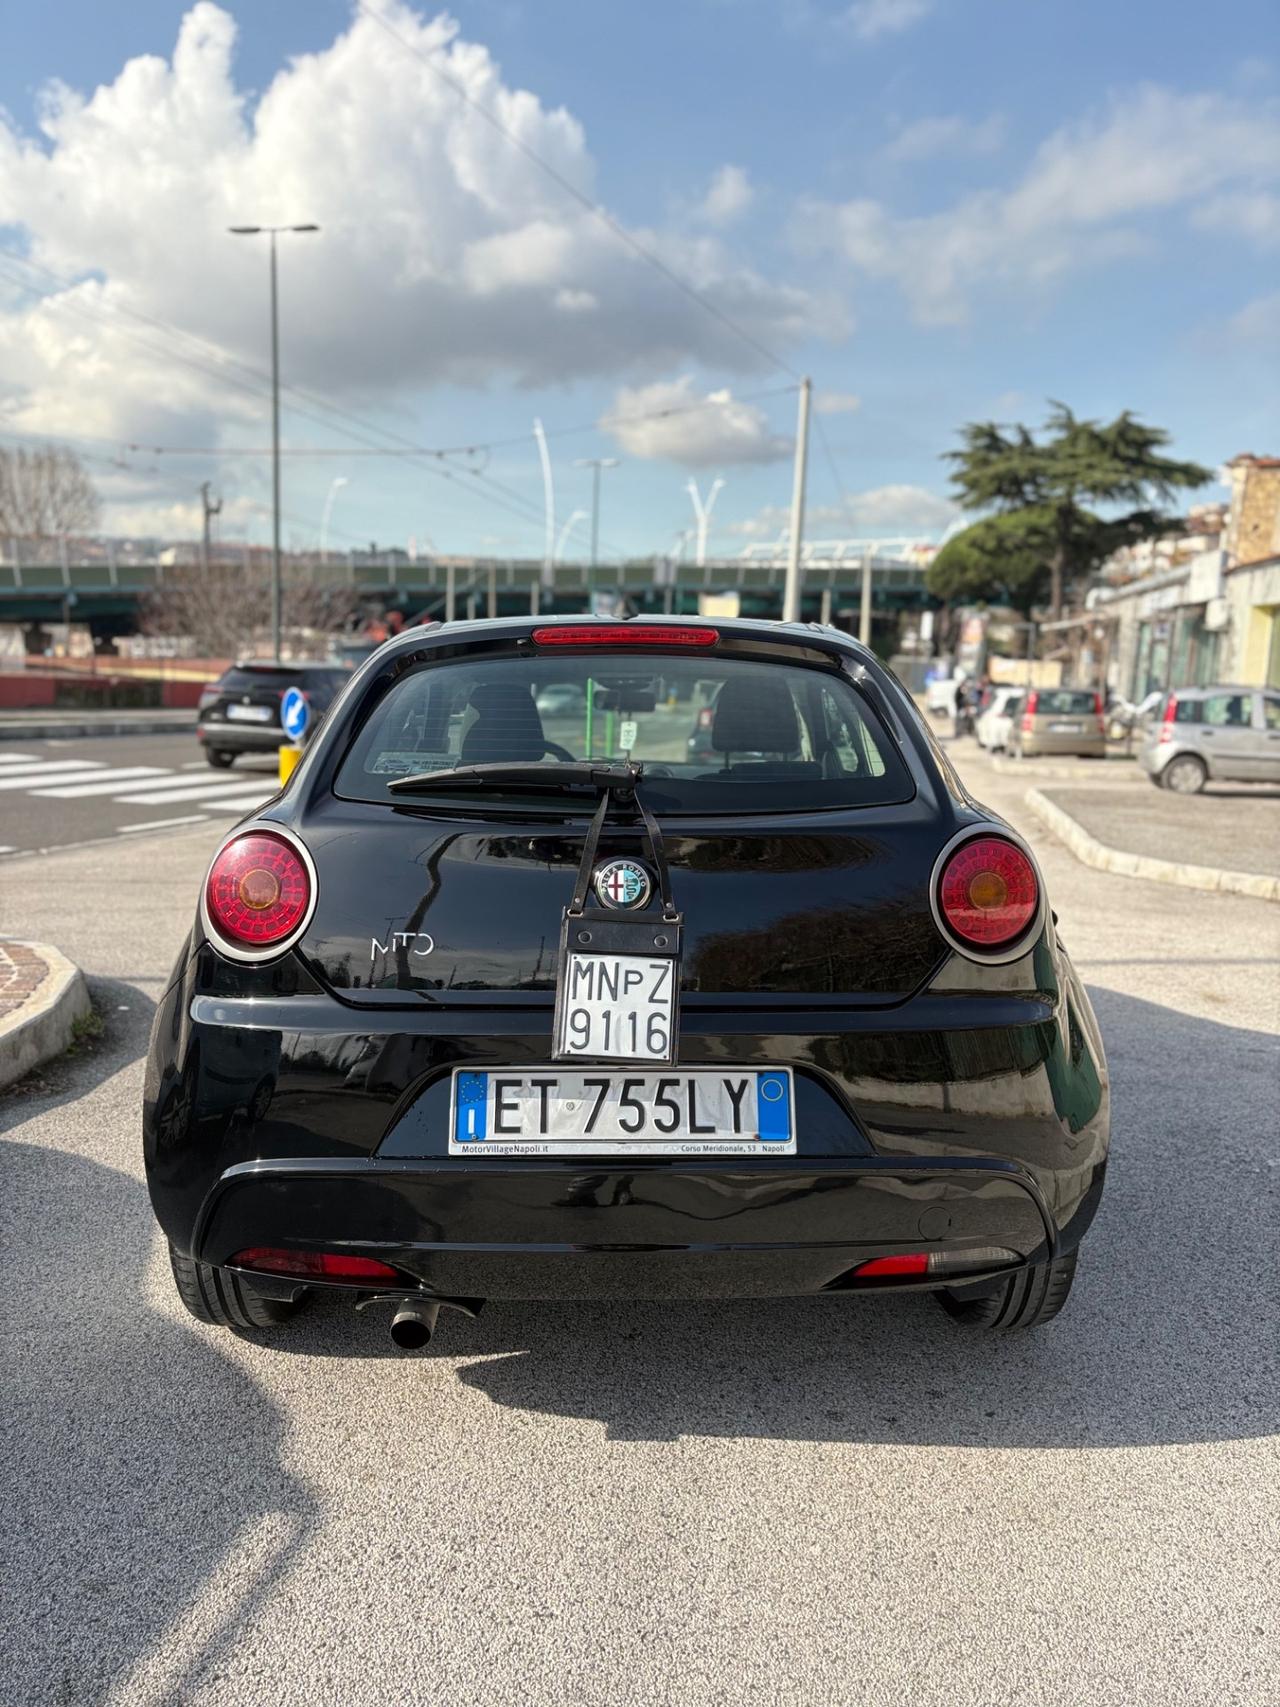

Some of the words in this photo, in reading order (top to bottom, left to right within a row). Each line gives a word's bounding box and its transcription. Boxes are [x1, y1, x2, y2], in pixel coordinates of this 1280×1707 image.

[601, 867, 618, 888] ALFA
[623, 864, 646, 888] ROMEO
[570, 1008, 668, 1054] 9116
[494, 1079, 557, 1133] ET
[583, 1079, 749, 1133] 755LY
[461, 1145, 549, 1155] MotorVillageNapoli.it
[703, 1145, 746, 1153] Meridionale,
[762, 1145, 785, 1153] Napoli
